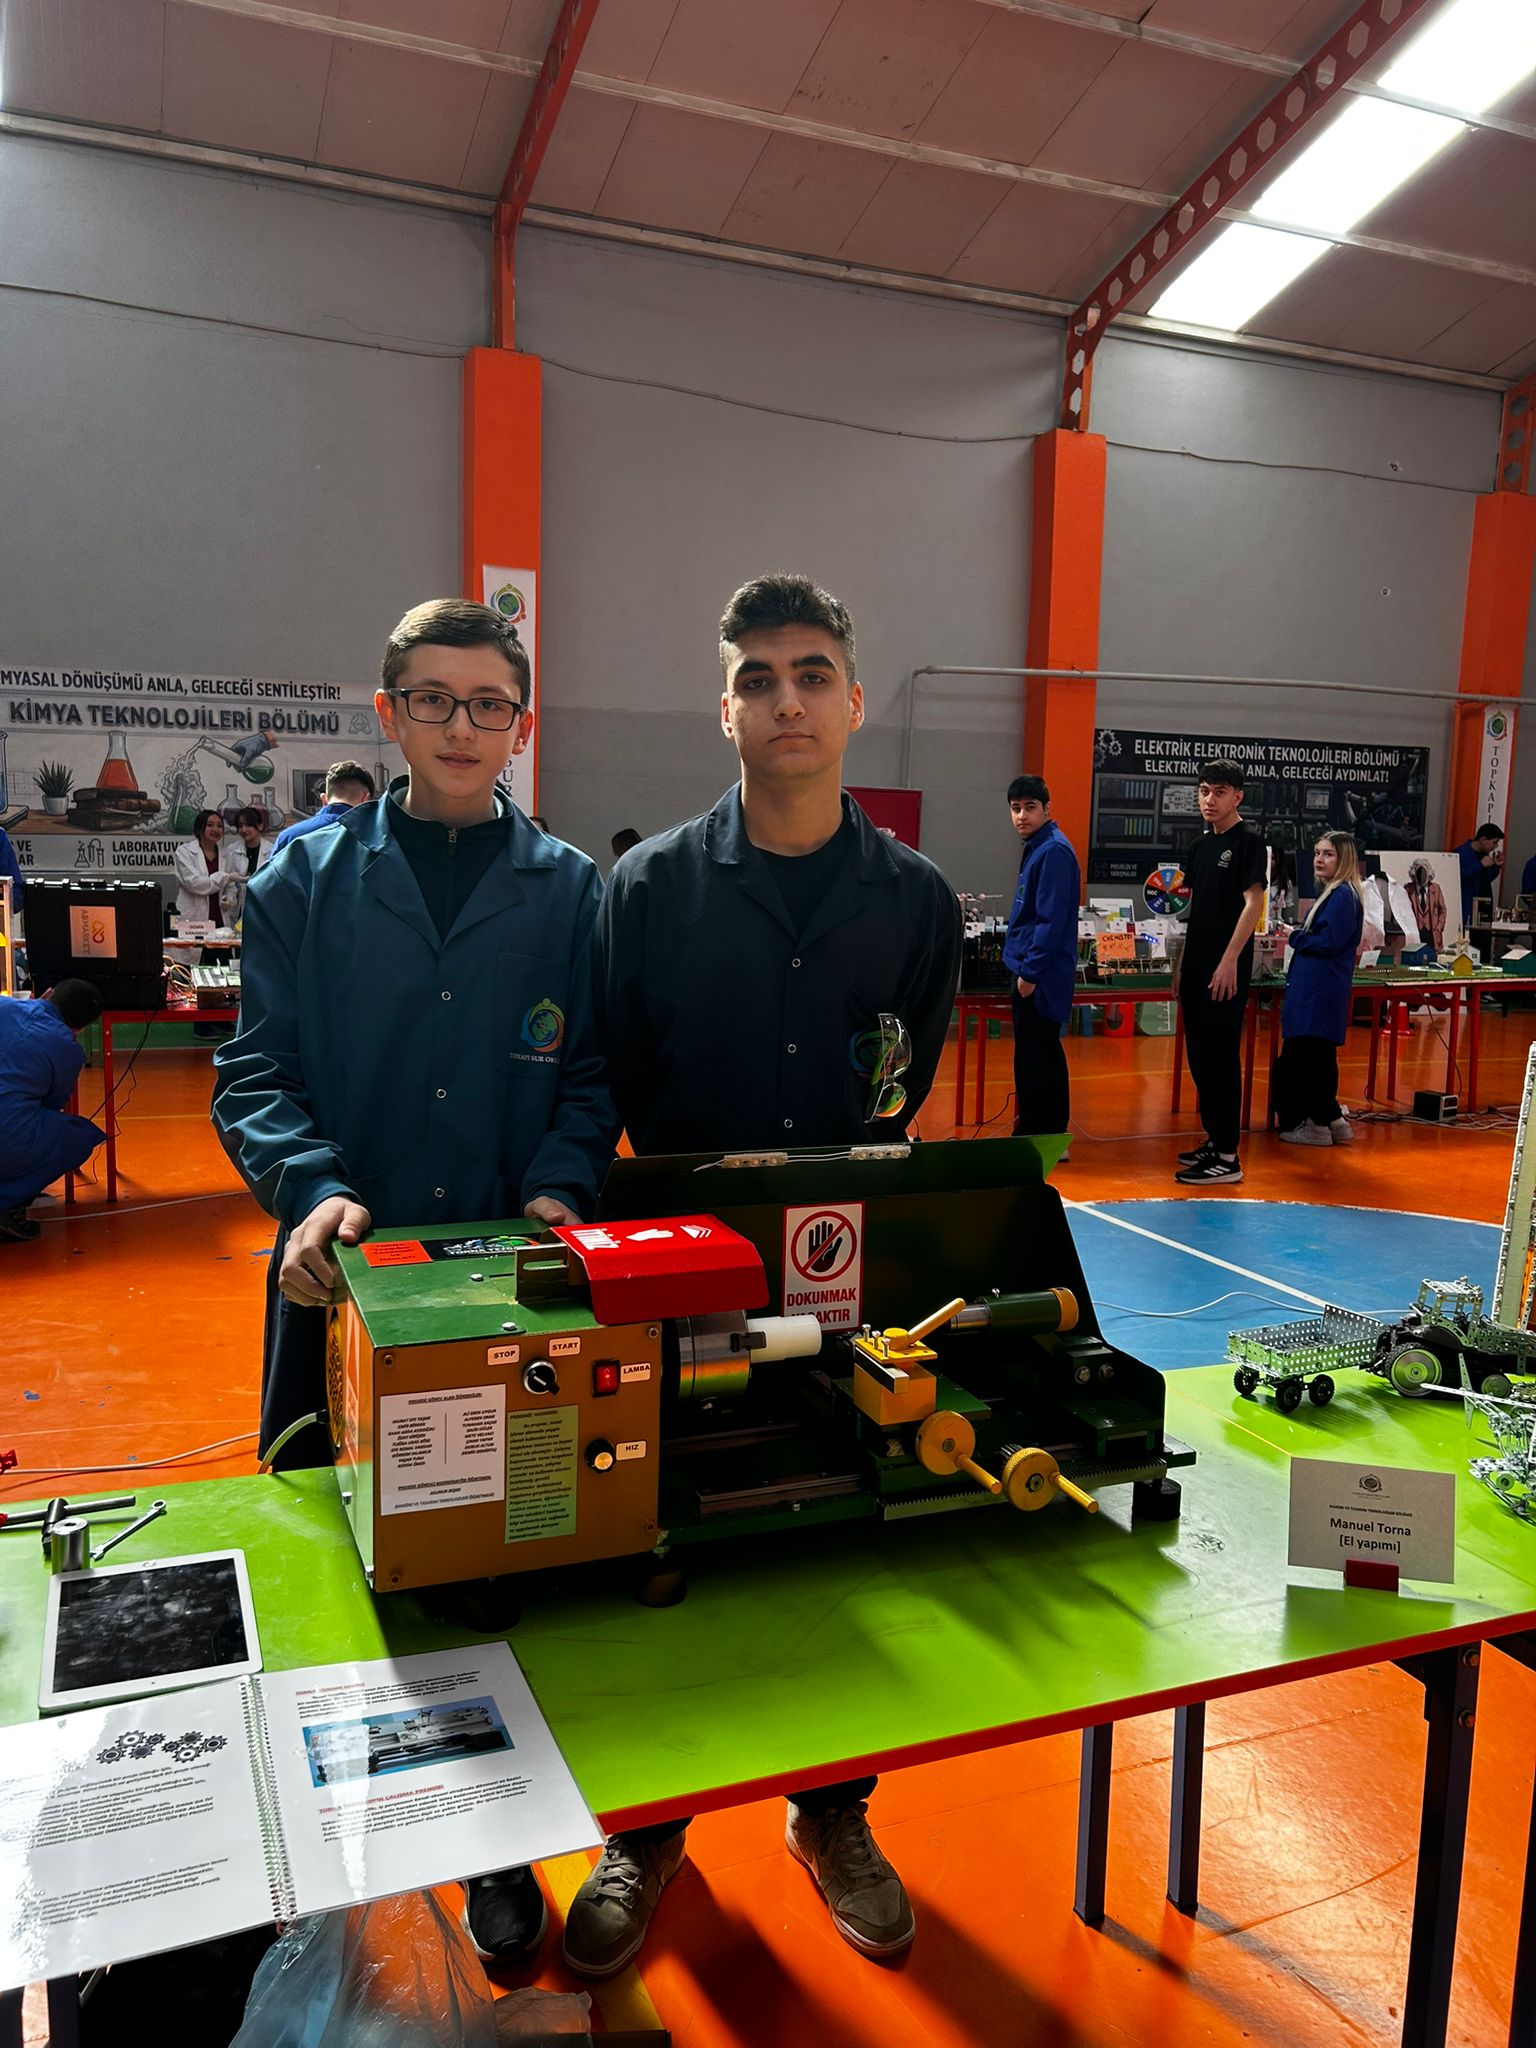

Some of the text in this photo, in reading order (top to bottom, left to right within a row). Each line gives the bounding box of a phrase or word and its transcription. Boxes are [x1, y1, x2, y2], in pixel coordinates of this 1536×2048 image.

[62, 670, 144, 692] DÖNÜŞÜMÜ
[147, 677, 188, 695] ANLA,
[192, 678, 253, 696] GELECEĞİ
[256, 681, 341, 700] SENTİLEŞTİR!
[10, 698, 340, 734] KİMYA TEKNOLOJİLERİ BÖLÜMÜ
[1134, 738, 1400, 767] ELEKTRİK ELEKTRONİK TEKNOLOJİLERİ BÖLÜMÜ
[1145, 758, 1200, 774] ELEKTRİK
[1246, 764, 1280, 780] ANLA,
[1282, 766, 1333, 780] GELECEĞİ
[1335, 768, 1390, 783] AYDINLAT!
[786, 1288, 856, 1307] DOKUNMAK
[494, 1350, 516, 1359] STOP
[552, 1342, 578, 1350] START
[623, 1365, 650, 1374] LAMBA
[1330, 1517, 1412, 1536] Manuel Torna
[1340, 1534, 1401, 1554] [El yapımı]
